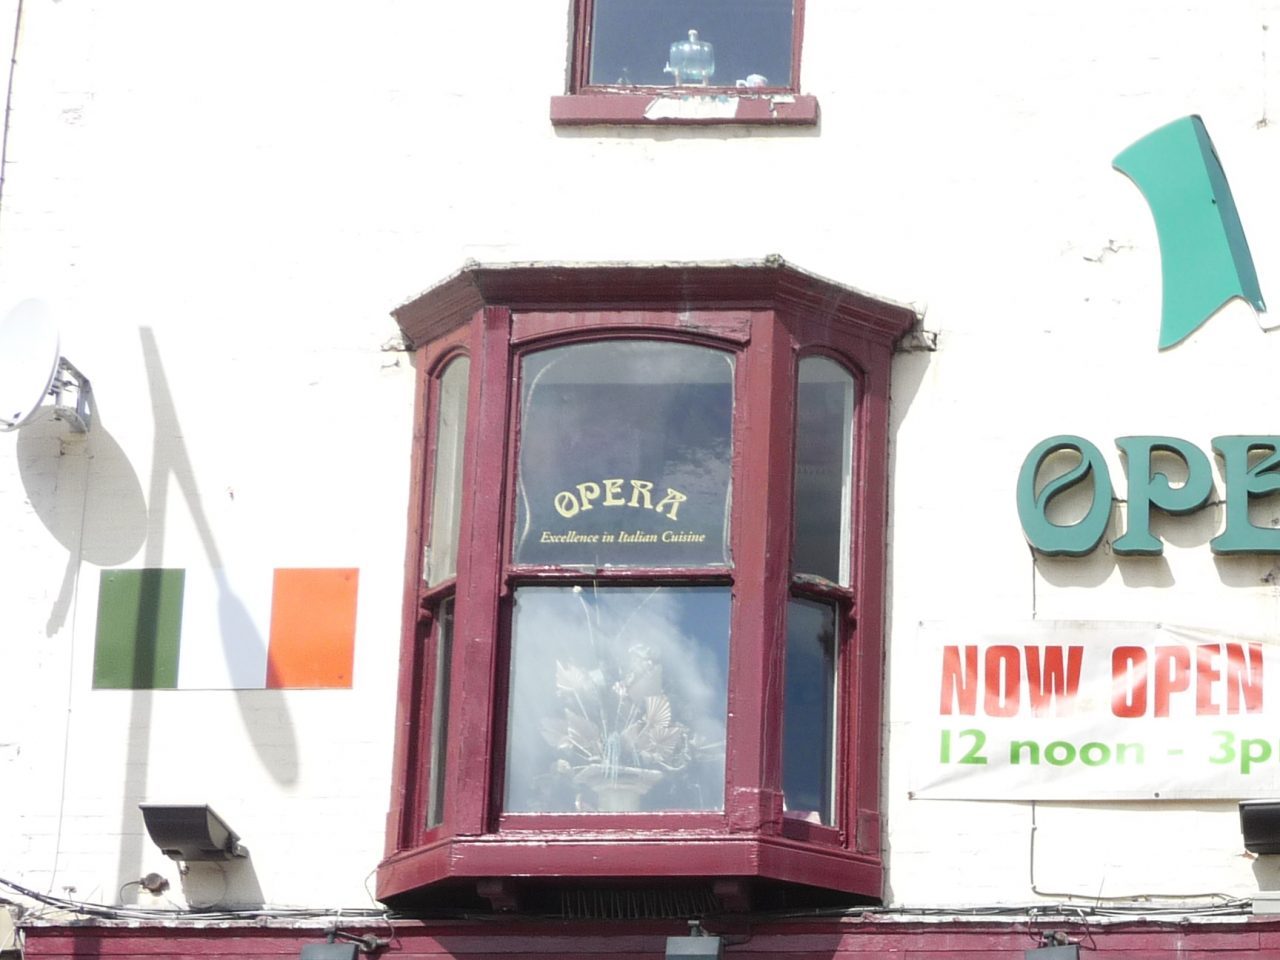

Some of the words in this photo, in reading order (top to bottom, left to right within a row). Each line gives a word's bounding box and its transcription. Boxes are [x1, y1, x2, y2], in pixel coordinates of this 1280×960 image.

[554, 479, 687, 520] OPERA
[540, 531, 599, 544] Excellence
[602, 531, 614, 543] in
[617, 531, 658, 543] Italian
[661, 531, 706, 543] Cuisine
[939, 645, 1083, 718] NOW
[1111, 642, 1263, 719] OPEN
[939, 728, 988, 766] 12
[1009, 737, 1145, 768] noon
